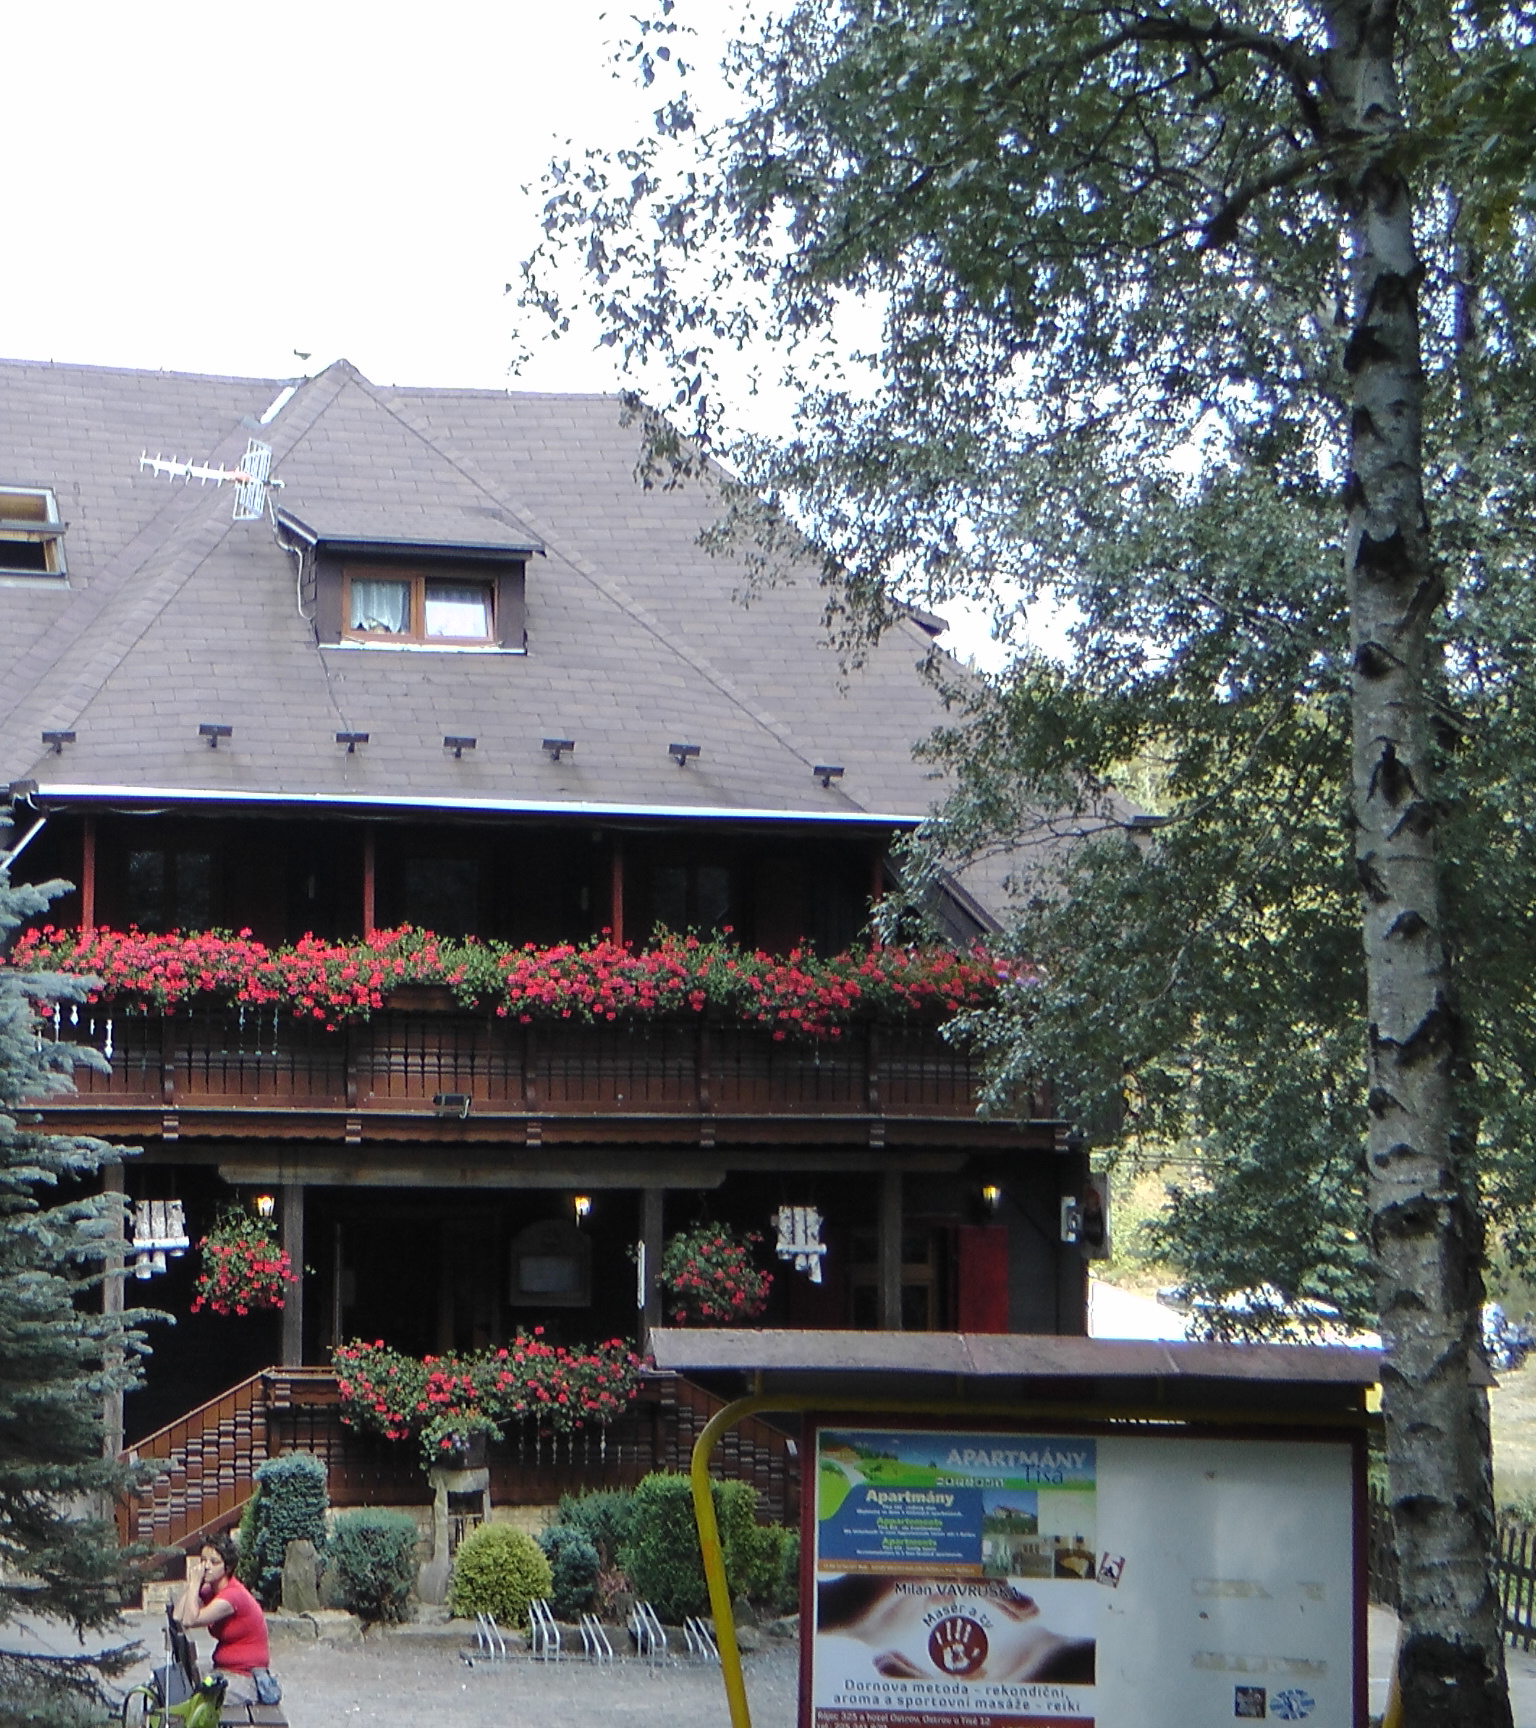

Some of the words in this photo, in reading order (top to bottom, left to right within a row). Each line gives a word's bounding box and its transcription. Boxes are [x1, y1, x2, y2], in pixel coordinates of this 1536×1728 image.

[946, 1447, 1087, 1469] APARTMÁNY
[865, 1489, 955, 1507] Apartmány
[895, 1582, 932, 1596] Milan
[969, 1606, 978, 1617] a
[844, 1679, 908, 1692] Dornova
[913, 1682, 969, 1695] metoda
[833, 1694, 880, 1705] aroma
[884, 1696, 892, 1705] a
[897, 1696, 971, 1709] sportovní
[975, 1697, 1031, 1710] masáže
[1046, 1699, 1081, 1712] reiki
